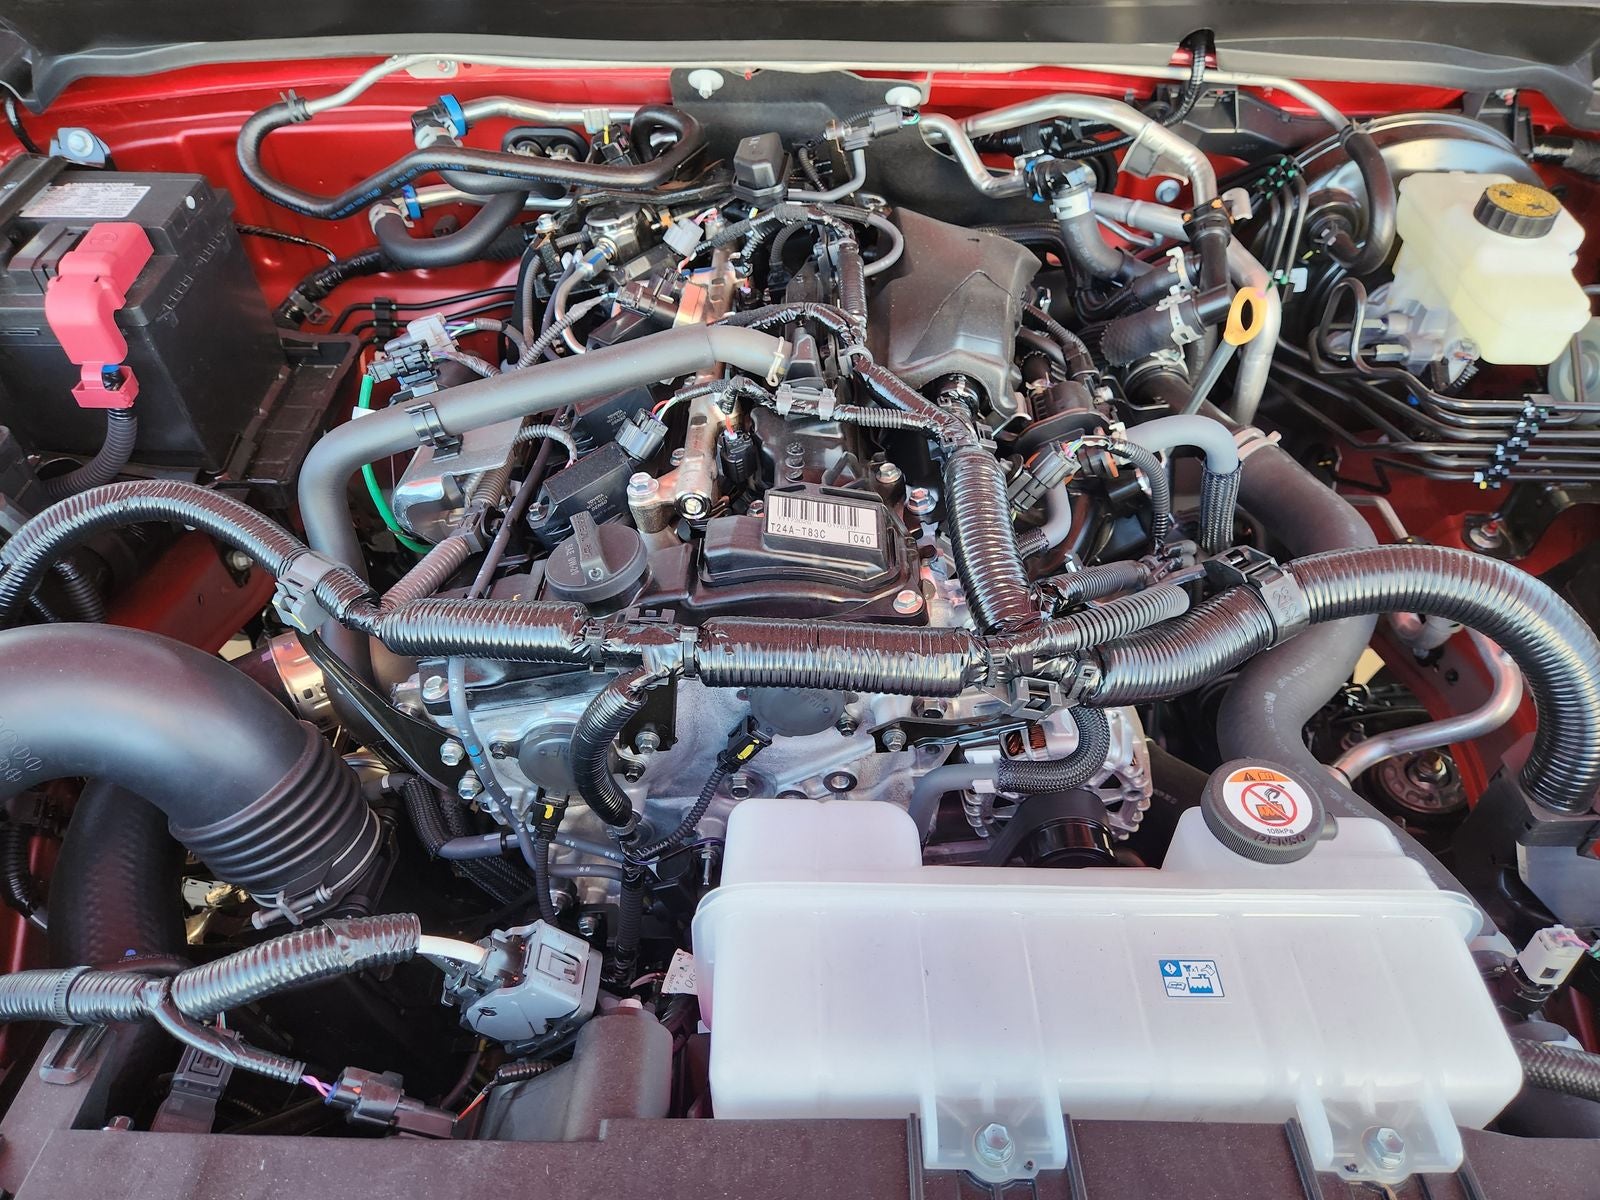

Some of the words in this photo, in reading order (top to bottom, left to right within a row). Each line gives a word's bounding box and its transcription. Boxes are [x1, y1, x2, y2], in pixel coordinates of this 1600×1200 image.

[586, 493, 604, 505] TOYOTA
[770, 522, 826, 539] T24A-T83C
[853, 534, 871, 545] 040
